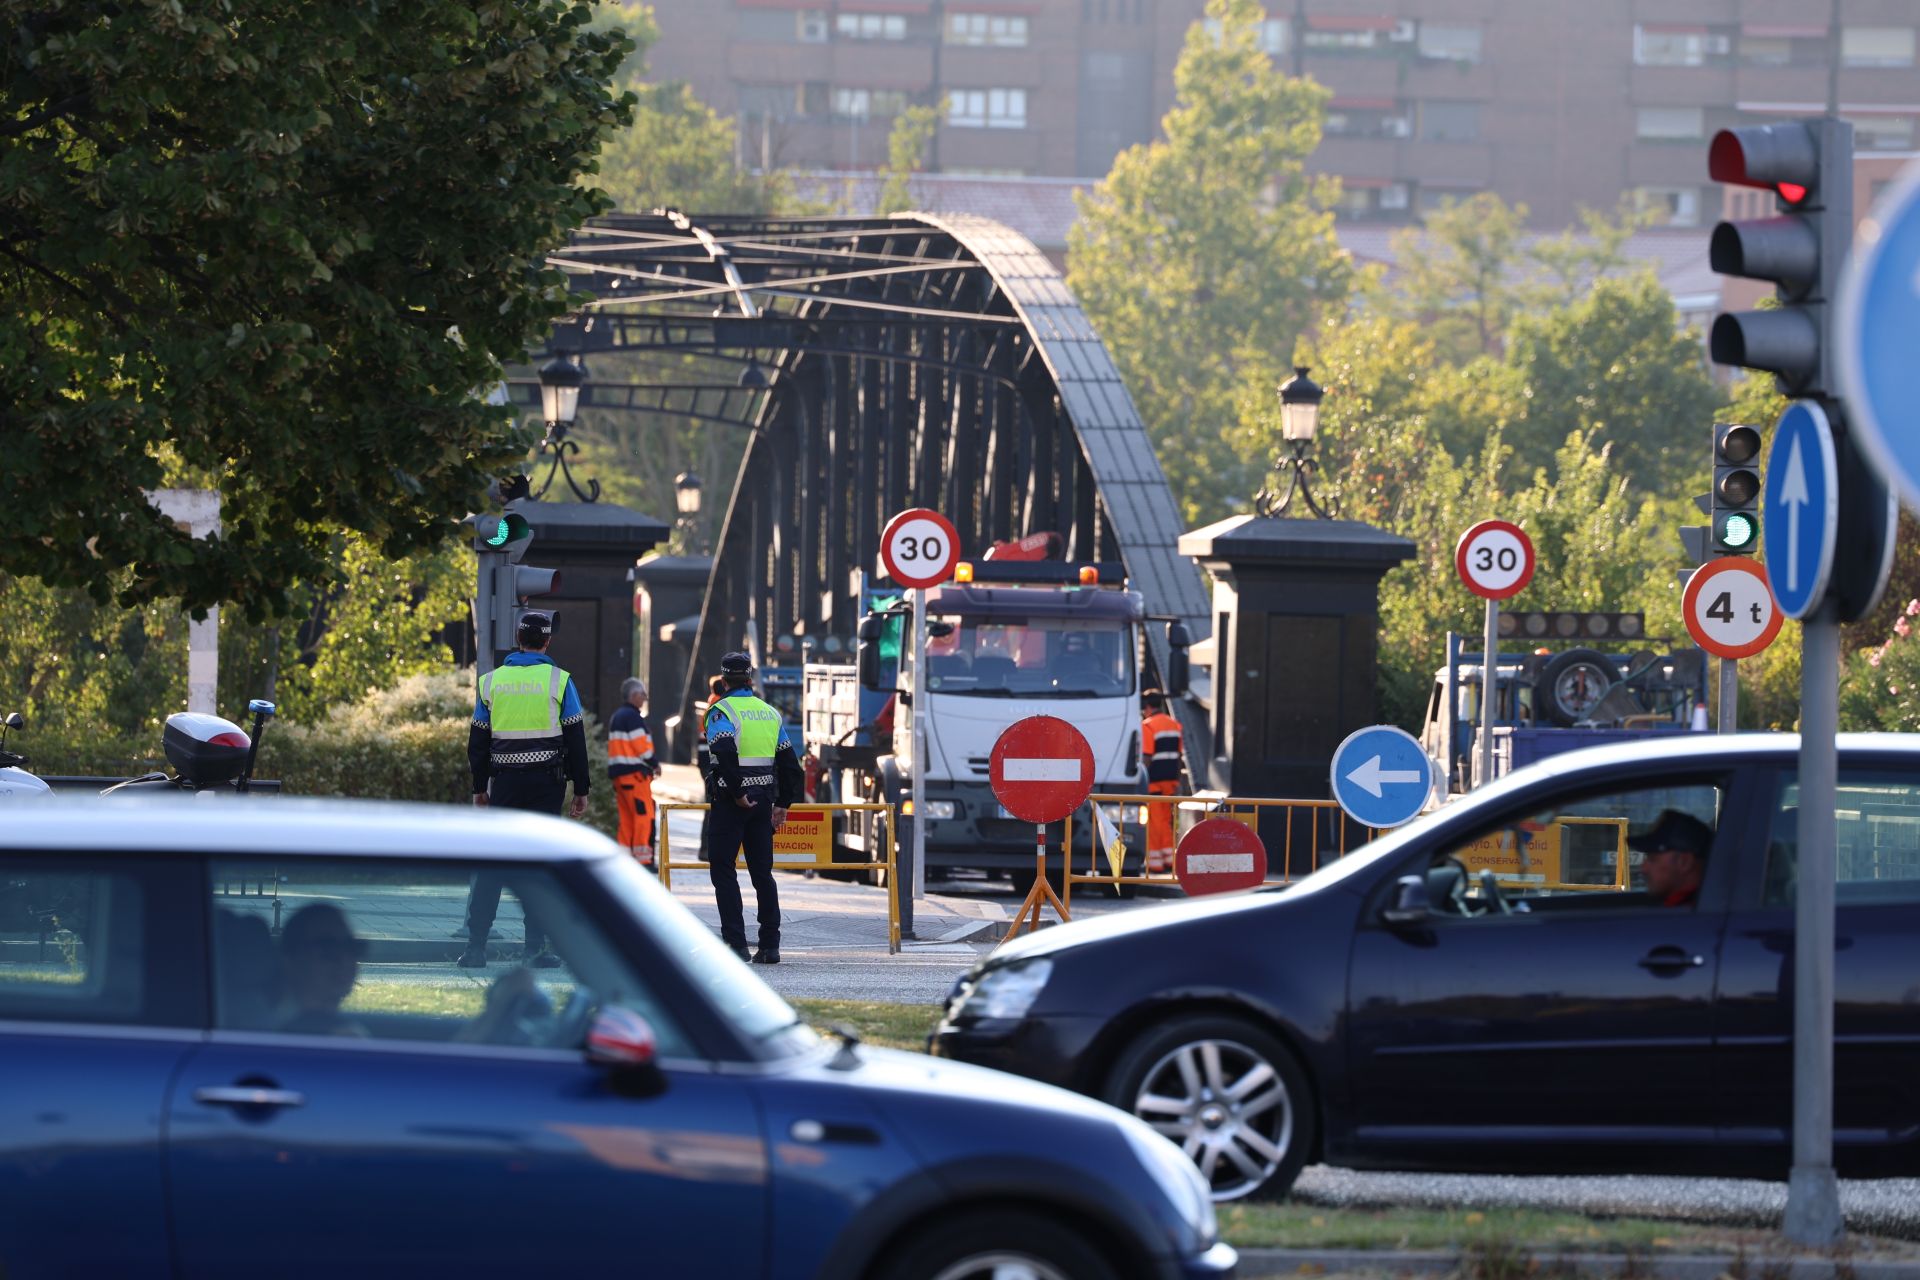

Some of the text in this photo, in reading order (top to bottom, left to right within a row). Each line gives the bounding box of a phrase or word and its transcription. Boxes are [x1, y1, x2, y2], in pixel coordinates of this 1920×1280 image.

[900, 537, 941, 562] 30
[1475, 547, 1517, 572] 30
[1706, 591, 1762, 624] 4 t
[775, 823, 818, 836] alladolid
[1470, 856, 1543, 866] CONSERVAON
